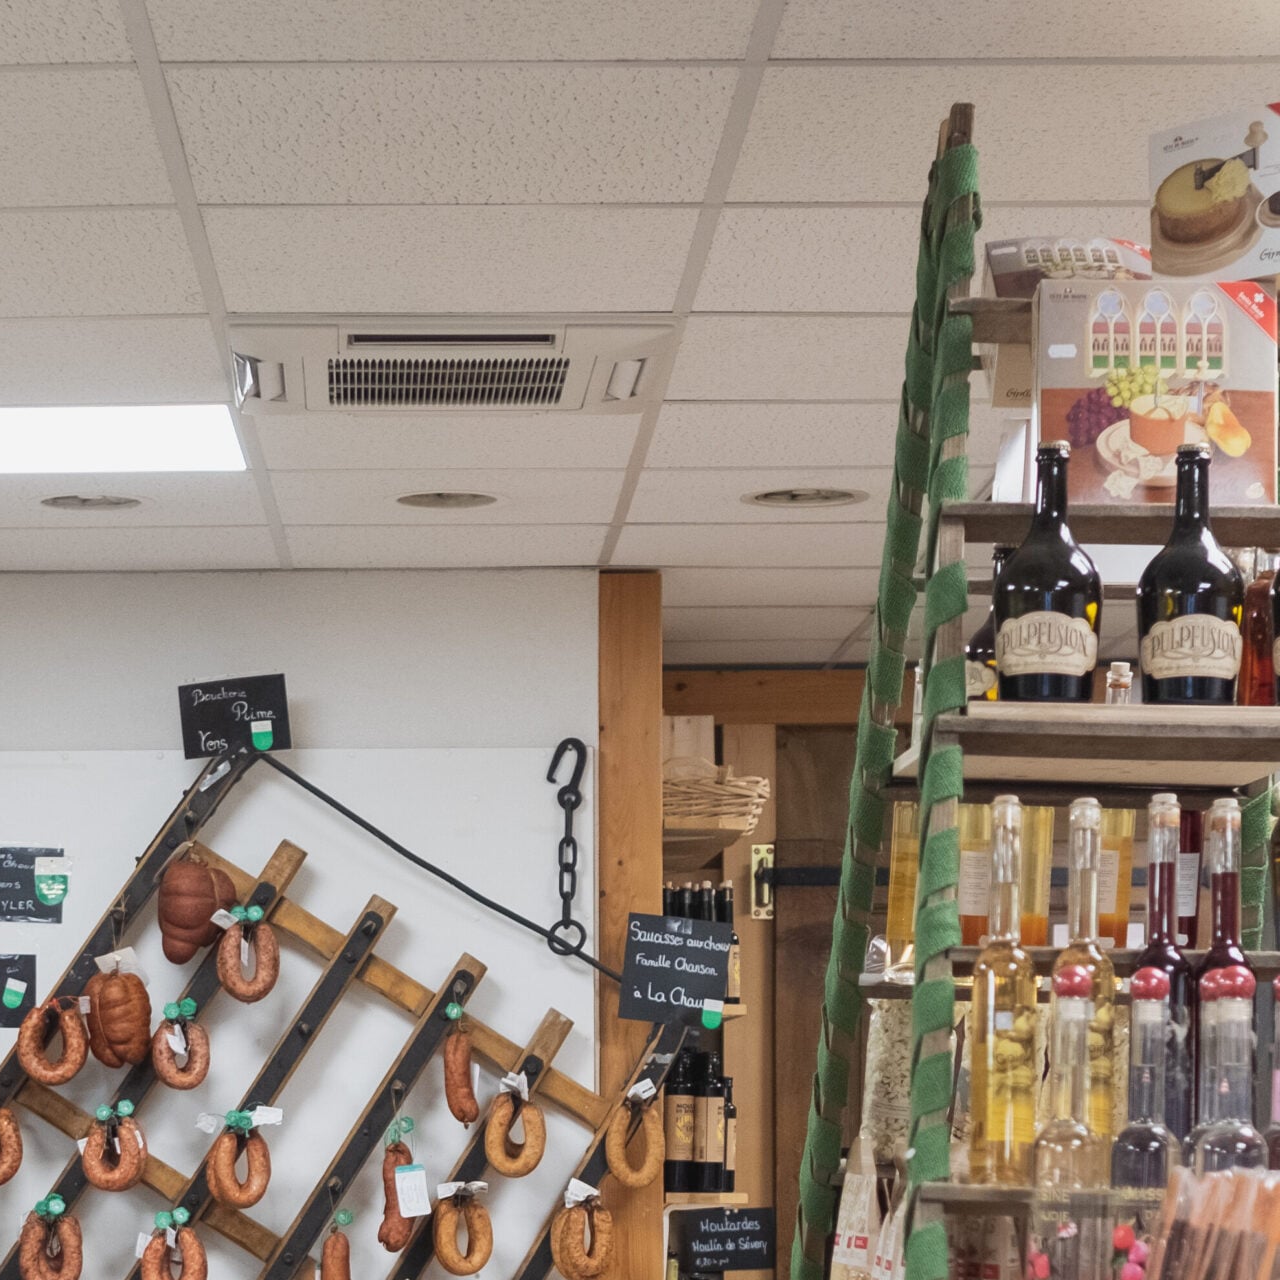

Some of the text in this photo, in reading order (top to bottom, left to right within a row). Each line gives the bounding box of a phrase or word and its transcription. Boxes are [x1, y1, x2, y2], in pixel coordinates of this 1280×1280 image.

[630, 920, 684, 946] Saucisses
[636, 953, 671, 968] Famille
[633, 982, 705, 1009] à La Chau
[725, 1238, 735, 1251] de
